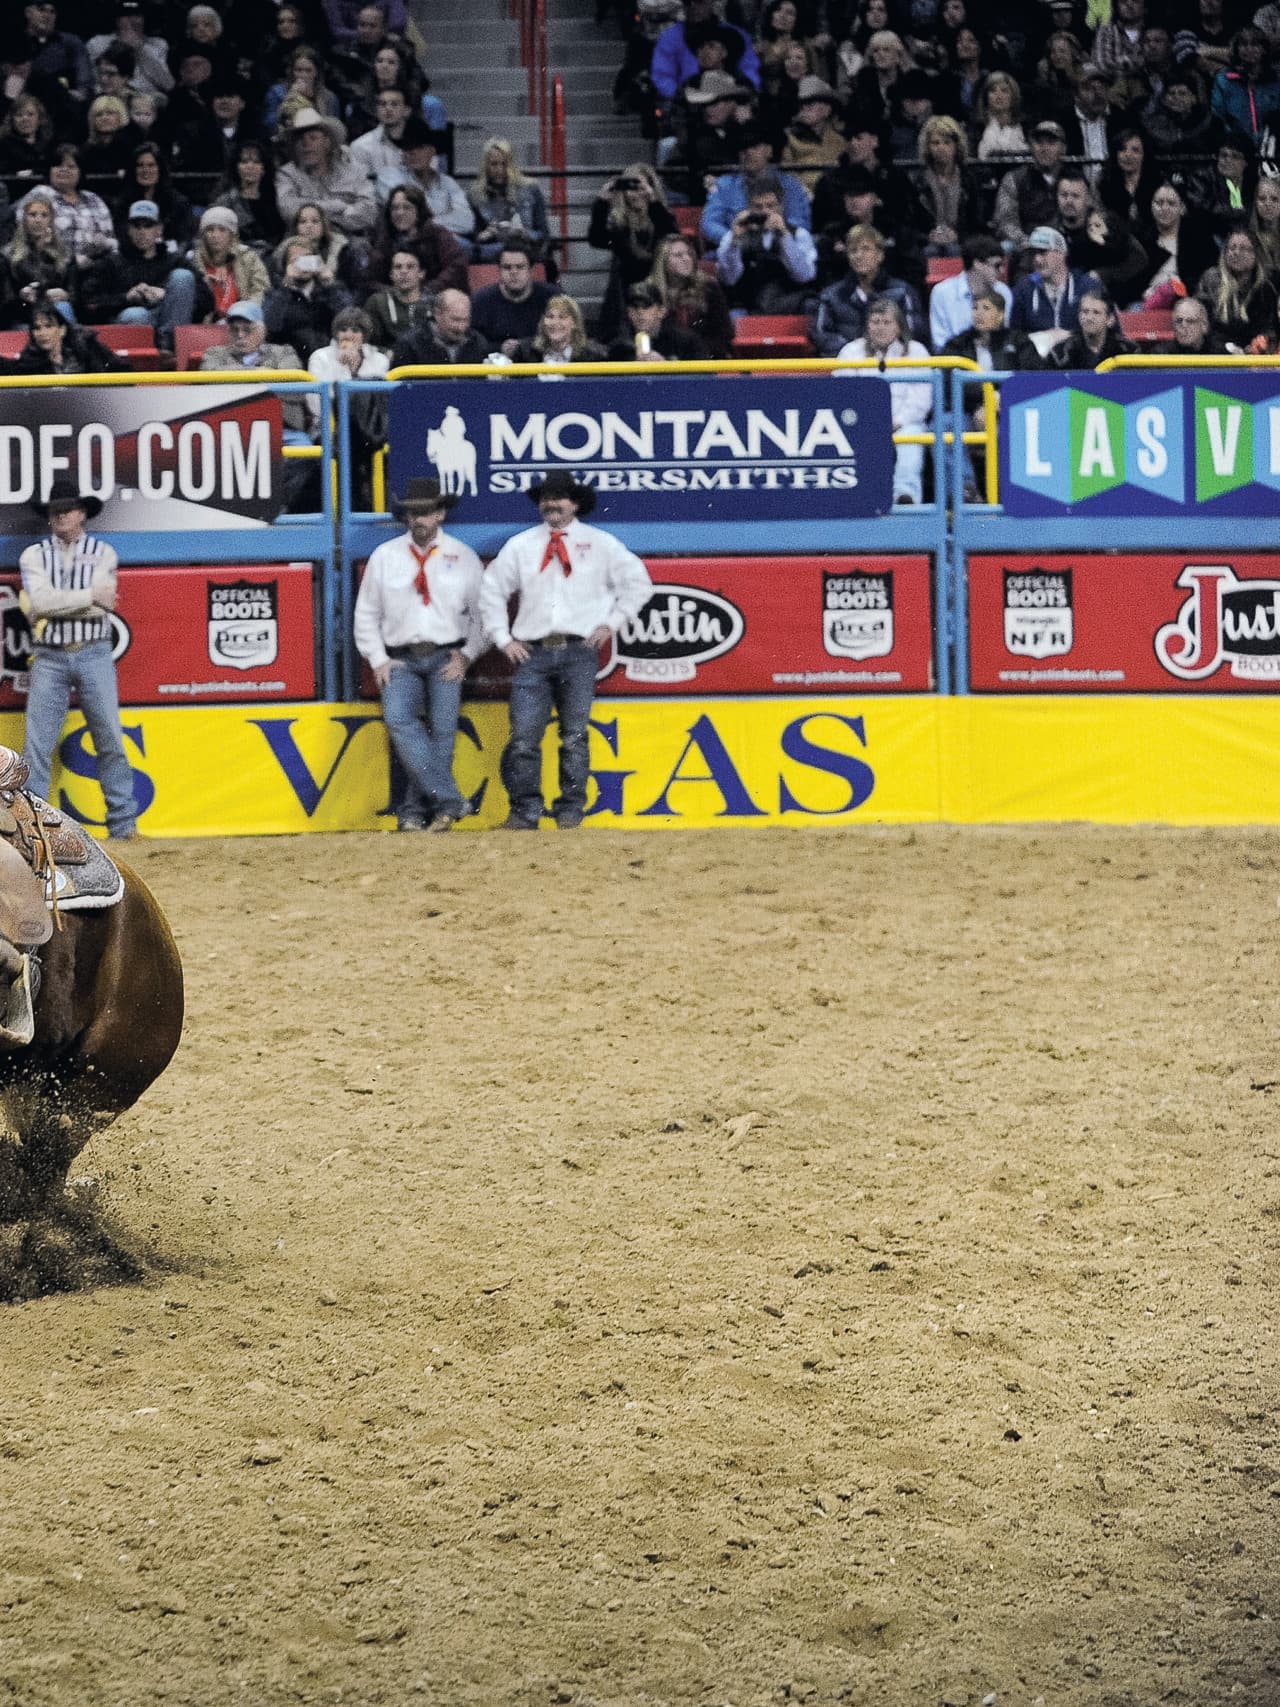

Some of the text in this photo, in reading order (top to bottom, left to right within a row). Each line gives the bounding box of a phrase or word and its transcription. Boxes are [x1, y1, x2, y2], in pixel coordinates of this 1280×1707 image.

[489, 408, 855, 461] MONTANA
[1024, 406, 1168, 478] LAS
[826, 578, 886, 592] OFFICIAL
[1006, 576, 1065, 589] OFFICIAL
[211, 588, 269, 602] OFFICIAL
[826, 591, 888, 609] BOOTS
[1006, 588, 1067, 607] BOOTS
[211, 602, 272, 620] BOOTS
[613, 594, 727, 652] ustin
[631, 661, 691, 676] BOOTS
